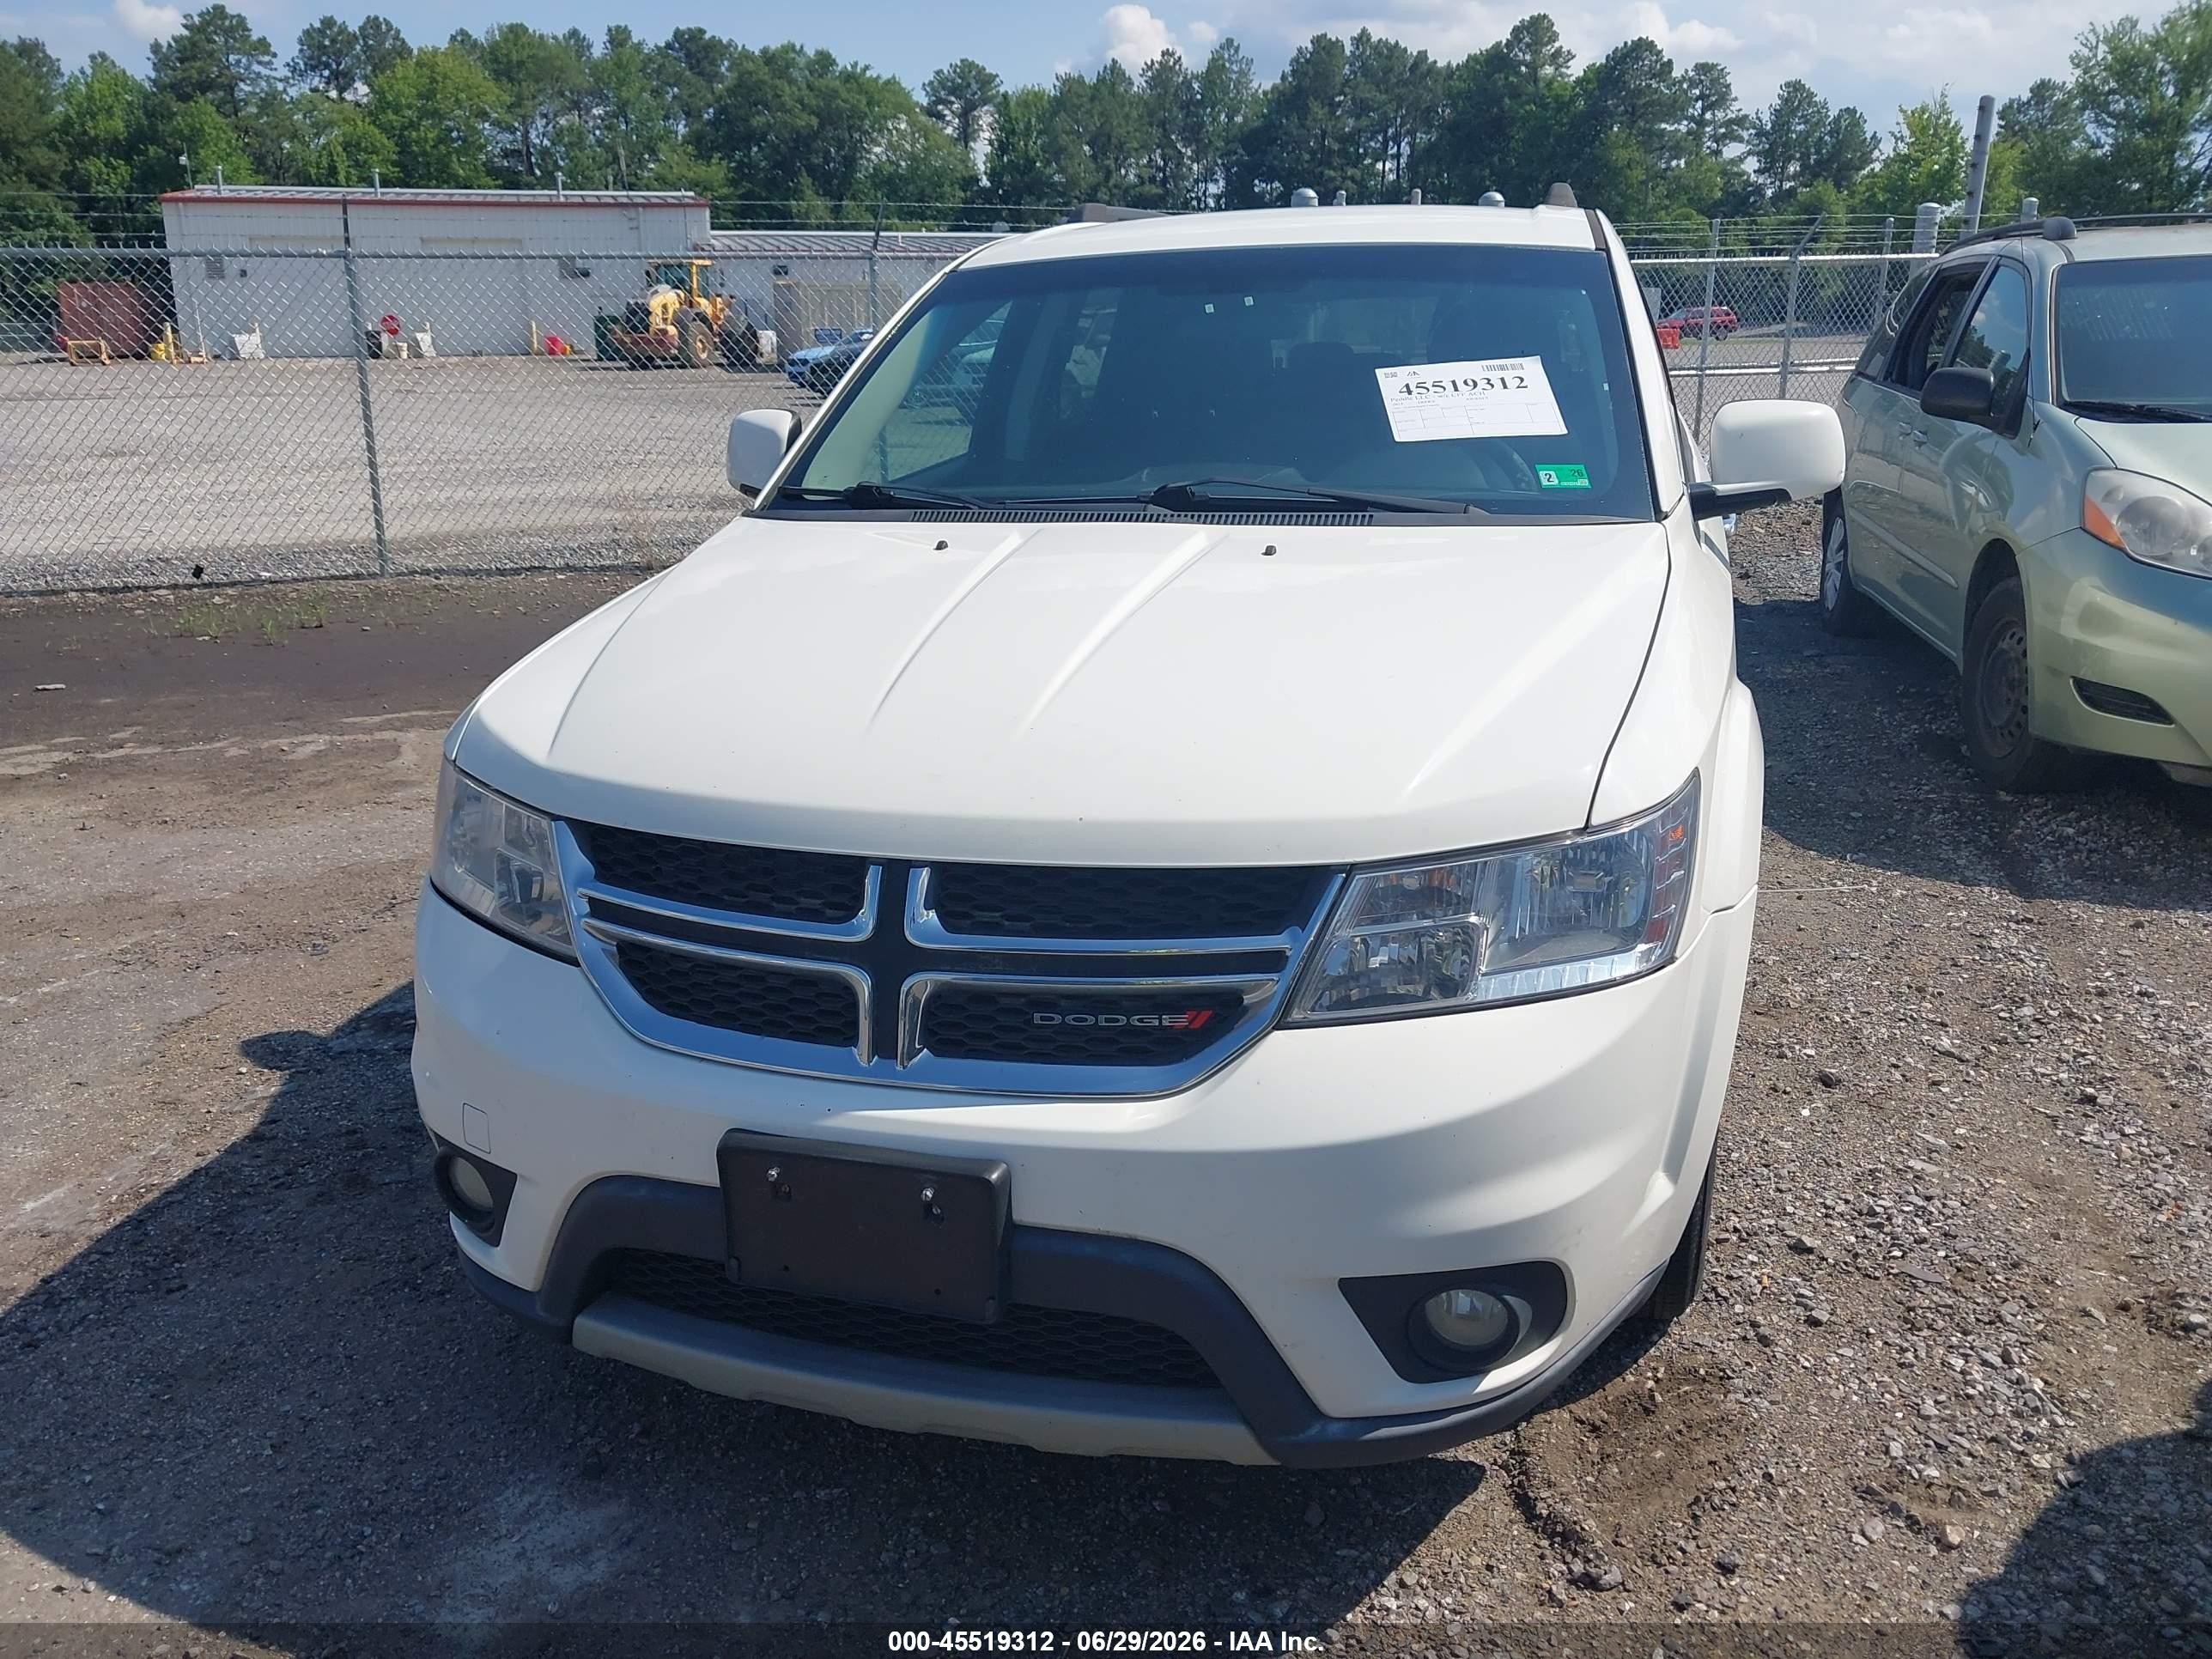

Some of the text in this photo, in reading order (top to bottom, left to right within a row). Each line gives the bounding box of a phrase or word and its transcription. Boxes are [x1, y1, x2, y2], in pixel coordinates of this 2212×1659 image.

[1399, 376, 1528, 396] 45519312
[1544, 472, 1554, 483] 2
[1033, 1012, 1189, 1026] DODGE
